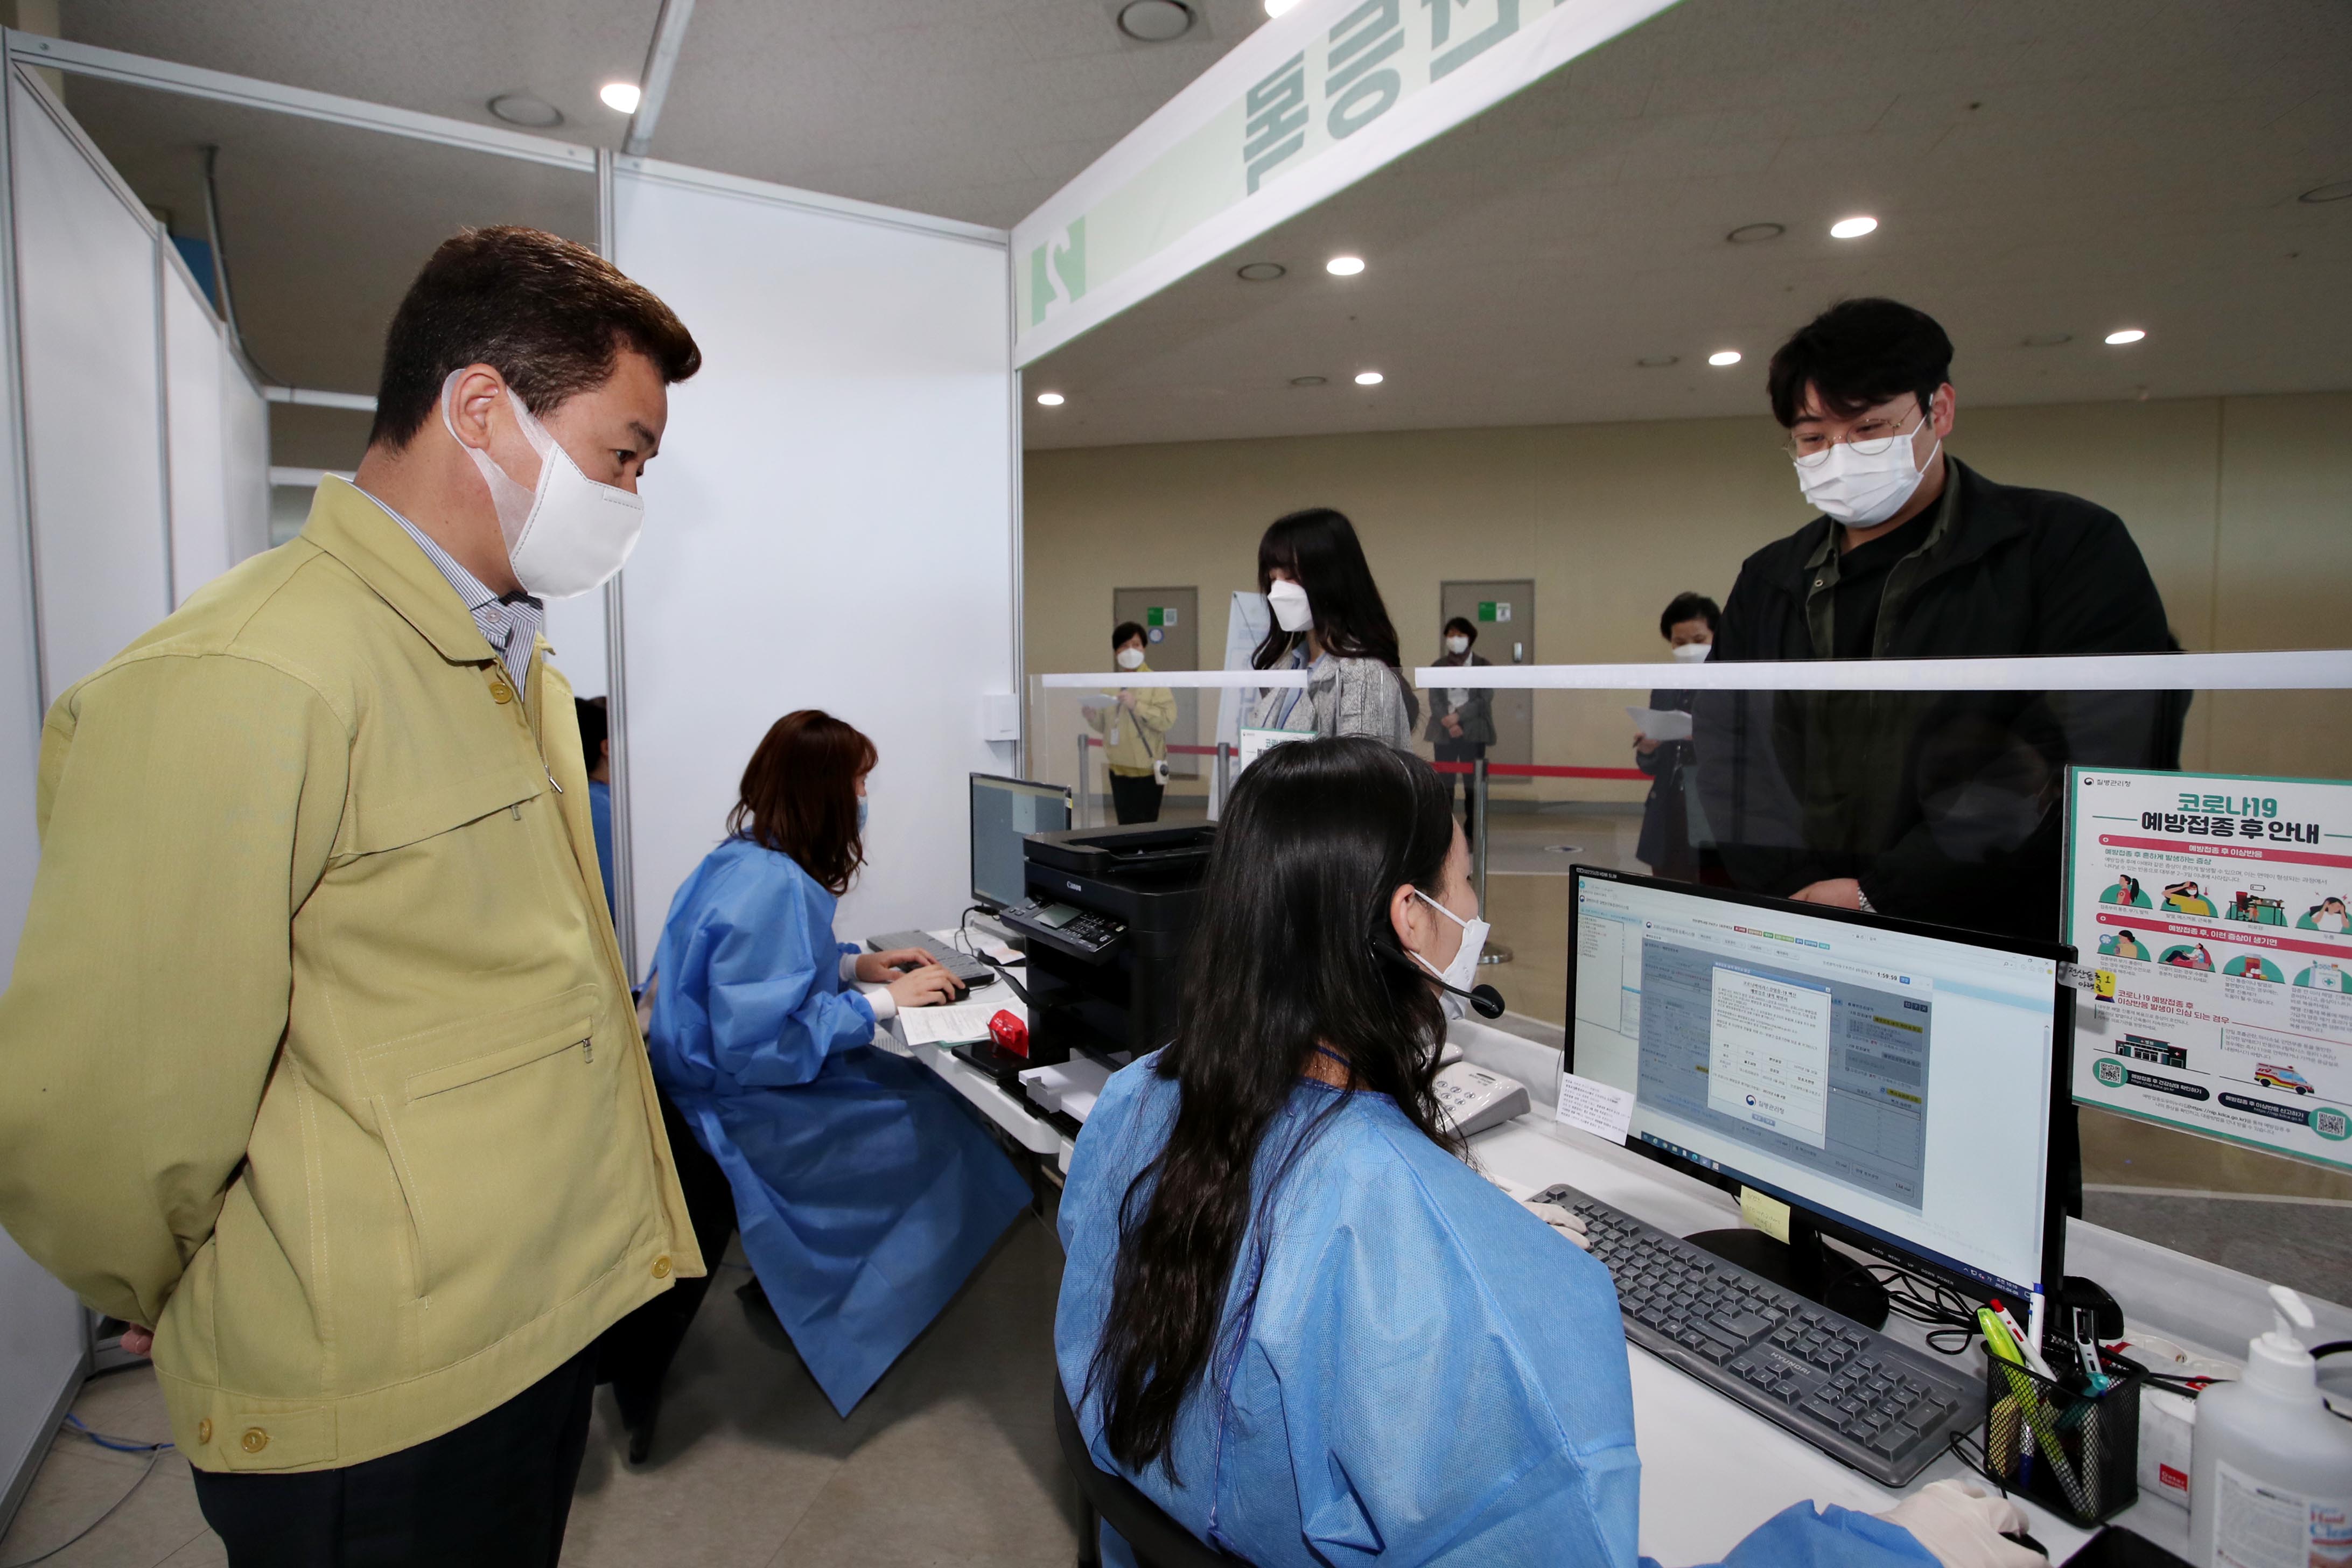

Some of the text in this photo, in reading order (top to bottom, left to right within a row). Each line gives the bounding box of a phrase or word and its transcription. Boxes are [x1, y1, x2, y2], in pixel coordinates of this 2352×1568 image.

[2097, 779, 2131, 787] 질병관리청
[2177, 793, 2277, 818] 코로나19
[2141, 811, 2319, 844] 예방접종 후 안내
[2105, 848, 2132, 857] 예방접종
[2143, 852, 2163, 860] 흔하게
[2165, 854, 2194, 863] 발생하는
[2189, 844, 2219, 855] 예방접종
[2231, 849, 2263, 858] 이상반응
[1067, 880, 1081, 892] Canon
[2169, 925, 2277, 947] 예방접종 후, 이런 증상이 생기면
[1877, 971, 1897, 981] 1:59:59
[2152, 996, 2193, 1010] 예방접종 후
[2118, 997, 2229, 1025] 이상반응 발생이 의심 되는 경우
[2131, 1073, 2151, 1082] 예방접종
[2180, 1084, 2201, 1094] 확인하기
[2225, 1095, 2248, 1105] 예방접종
[1758, 1100, 1784, 1115] 질병관리청
[1921, 1268, 1935, 1277] DOWN
[1937, 1275, 1954, 1285] POWER
[1770, 1352, 1811, 1375] HYUNDAI
